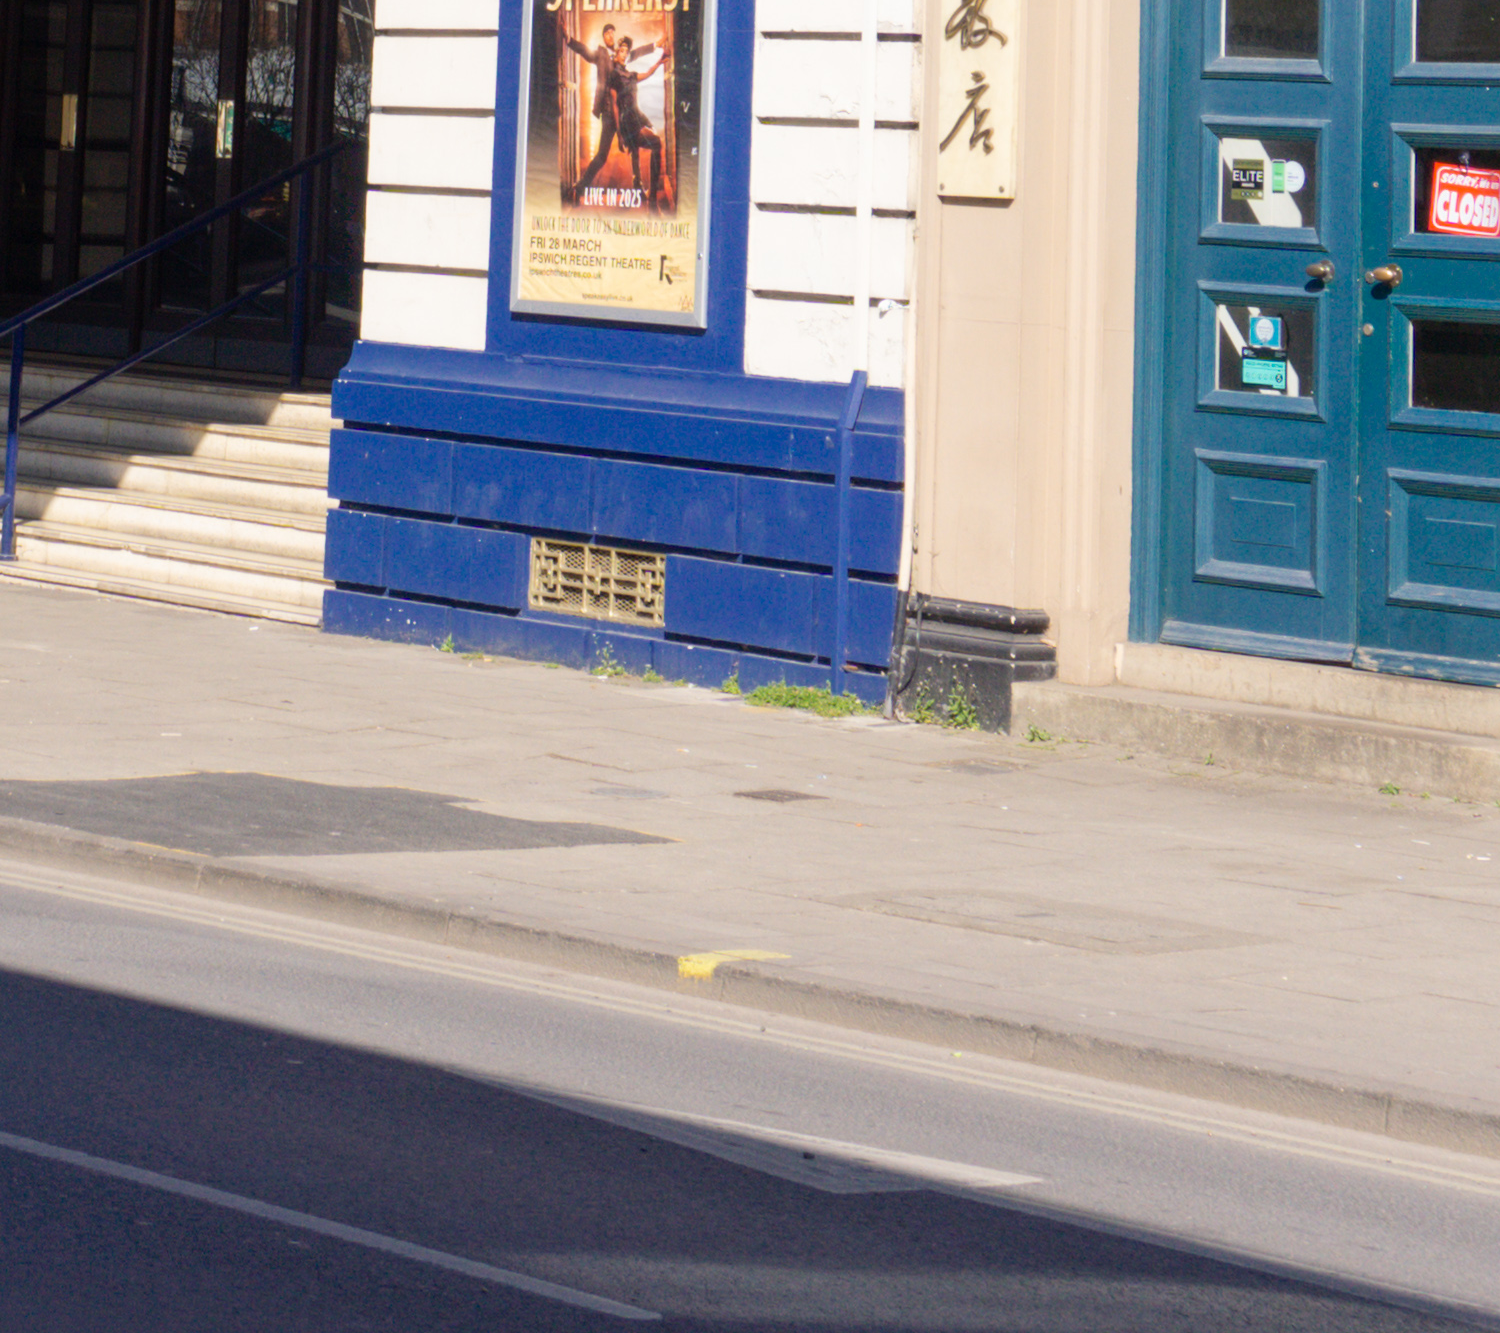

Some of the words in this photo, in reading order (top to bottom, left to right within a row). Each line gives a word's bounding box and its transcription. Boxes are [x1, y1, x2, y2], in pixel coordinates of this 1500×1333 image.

[1232, 169, 1264, 182] ELITE
[584, 187, 604, 206] LIVE
[606, 188, 618, 207] IN
[619, 189, 642, 208] 2025
[1436, 189, 1499, 228] CLOSED
[531, 216, 556, 232] UNLOCK
[557, 217, 570, 233] THE
[571, 218, 591, 233] DOOR
[593, 219, 601, 234] TO
[613, 220, 658, 237] UNDERWORLD
[660, 222, 670, 238] OF
[670, 222, 690, 239] DANCE
[530, 236, 546, 249] FRI
[548, 237, 560, 250] 28
[563, 238, 602, 252] MARCH
[529, 252, 567, 266] IPSWICH
[569, 254, 608, 268] REGENT
[611, 257, 652, 271] THEATRE
[528, 266, 602, 280] ipswichtheatres.co.uk
